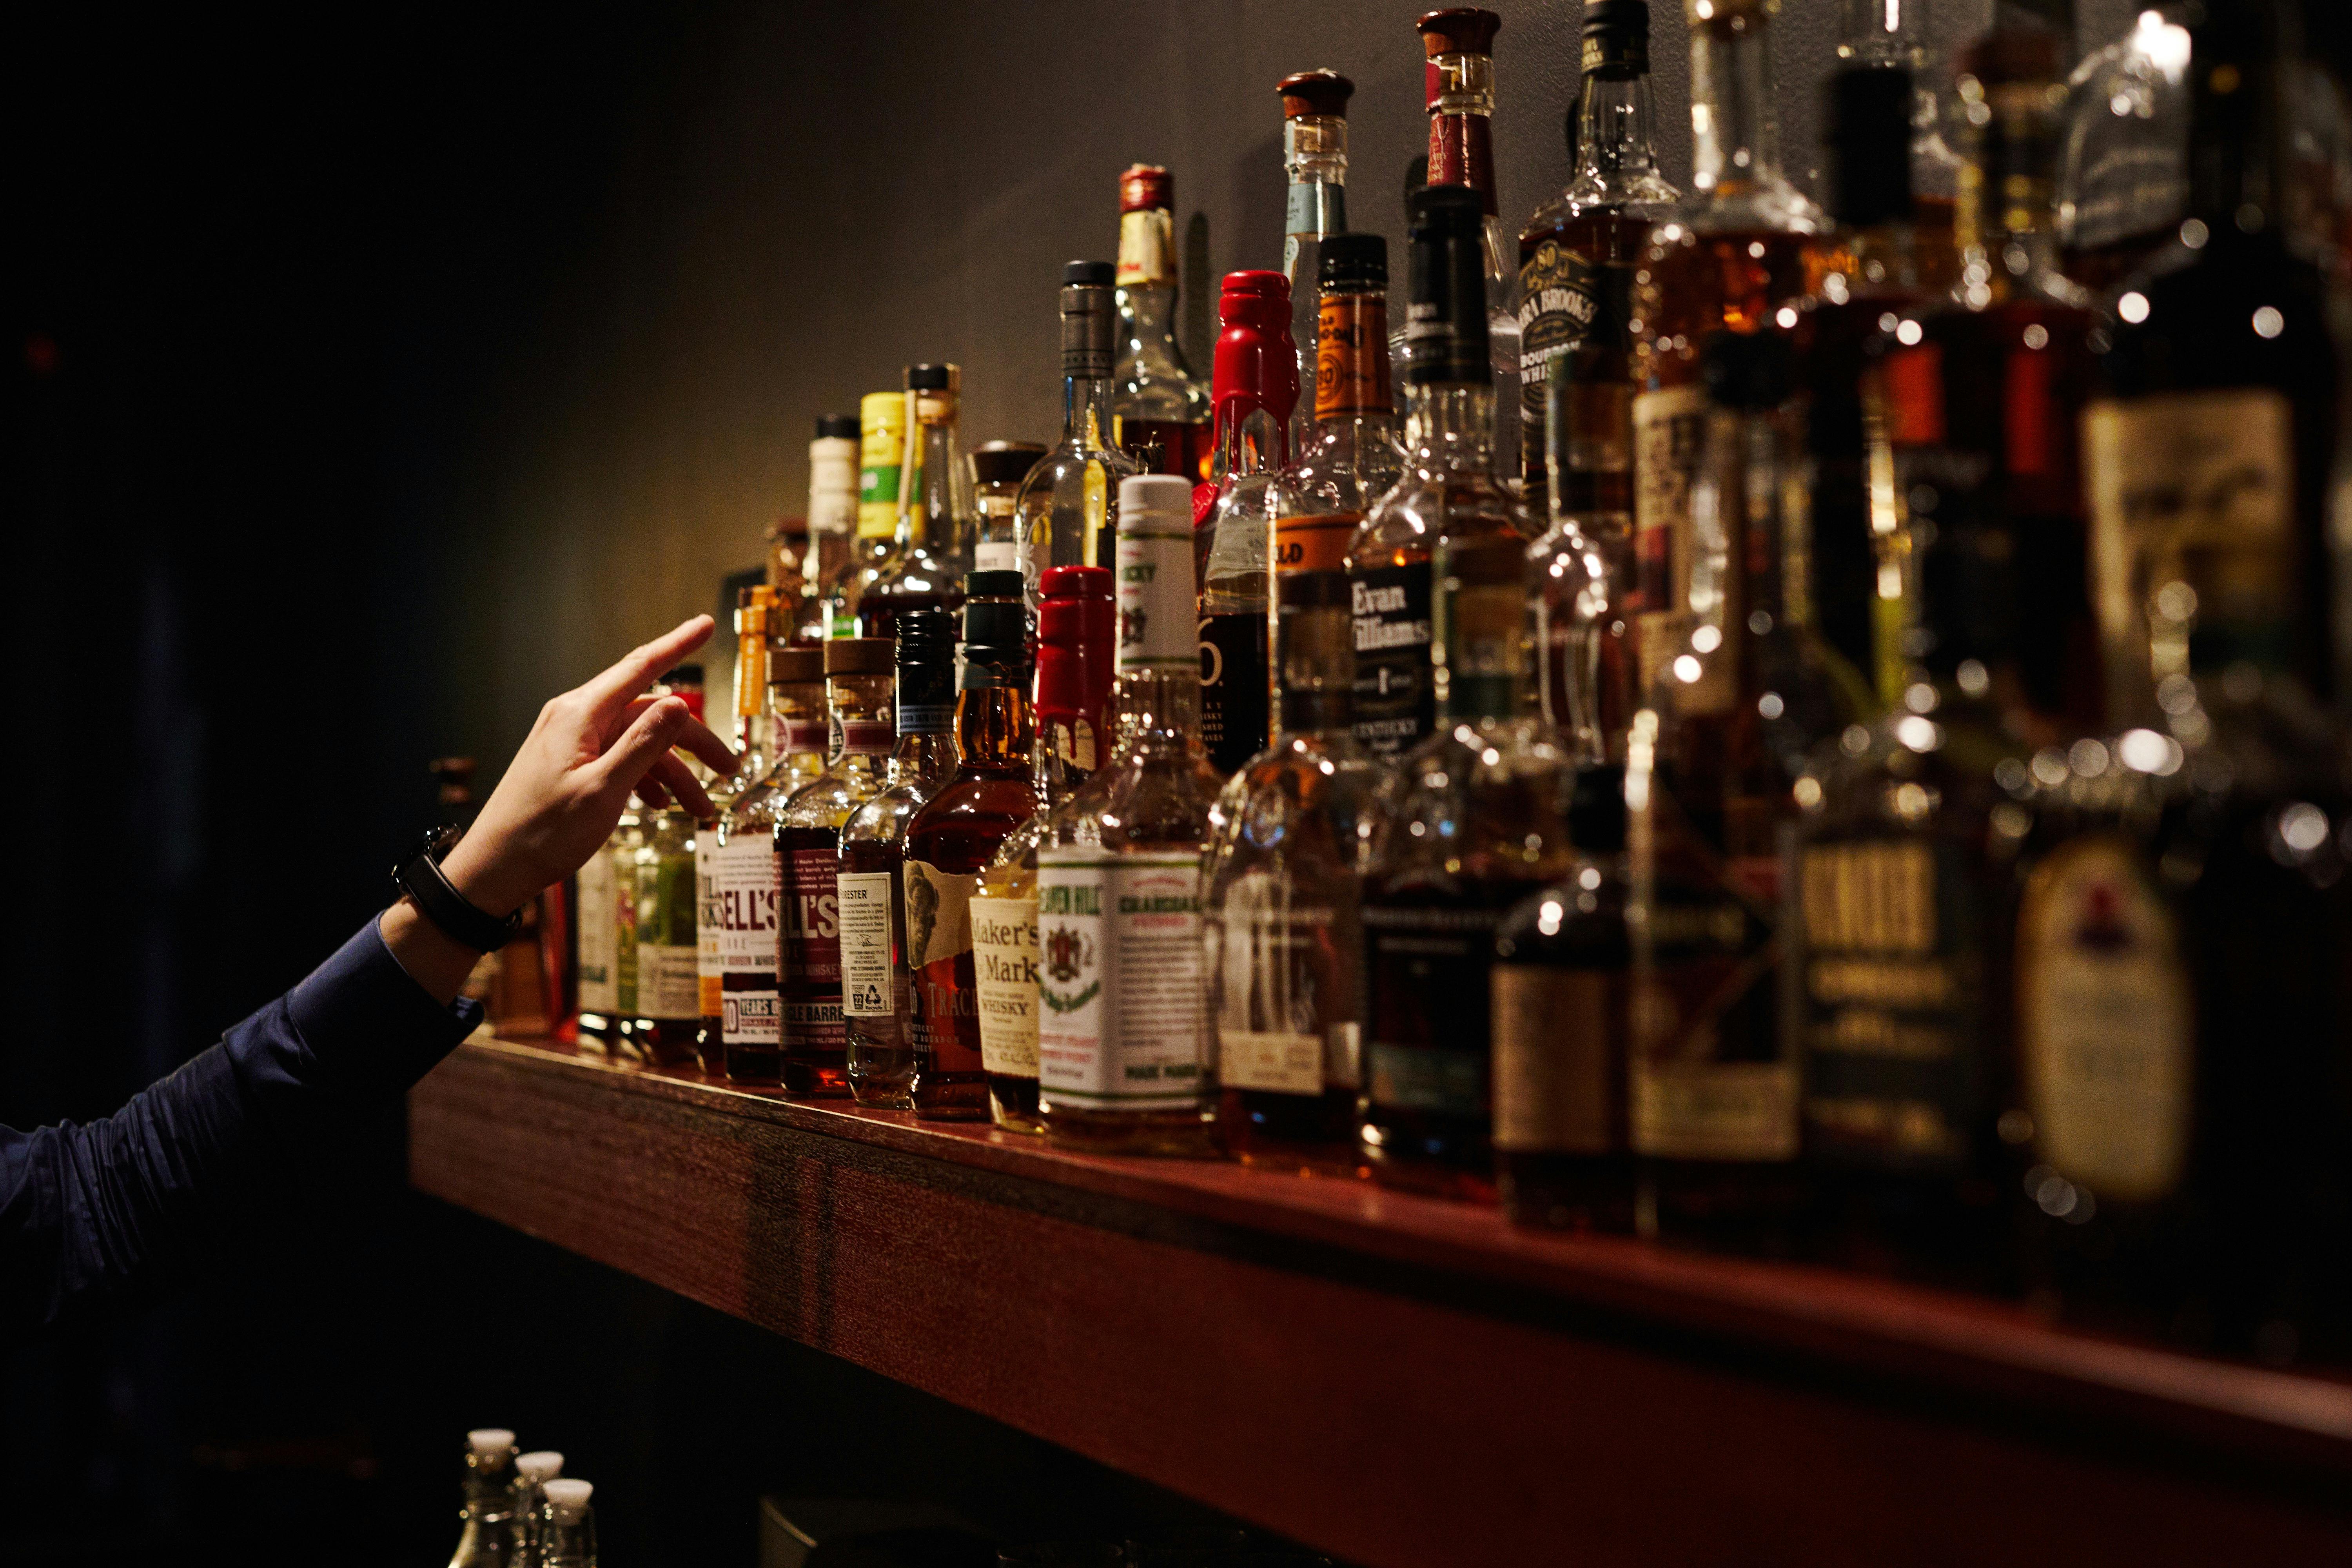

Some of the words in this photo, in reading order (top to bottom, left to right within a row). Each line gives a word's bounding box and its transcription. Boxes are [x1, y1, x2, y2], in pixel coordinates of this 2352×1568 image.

[1352, 582, 1408, 615] Evan
[985, 954, 1041, 984] Mark
[981, 998, 1029, 1016] WHISKY
